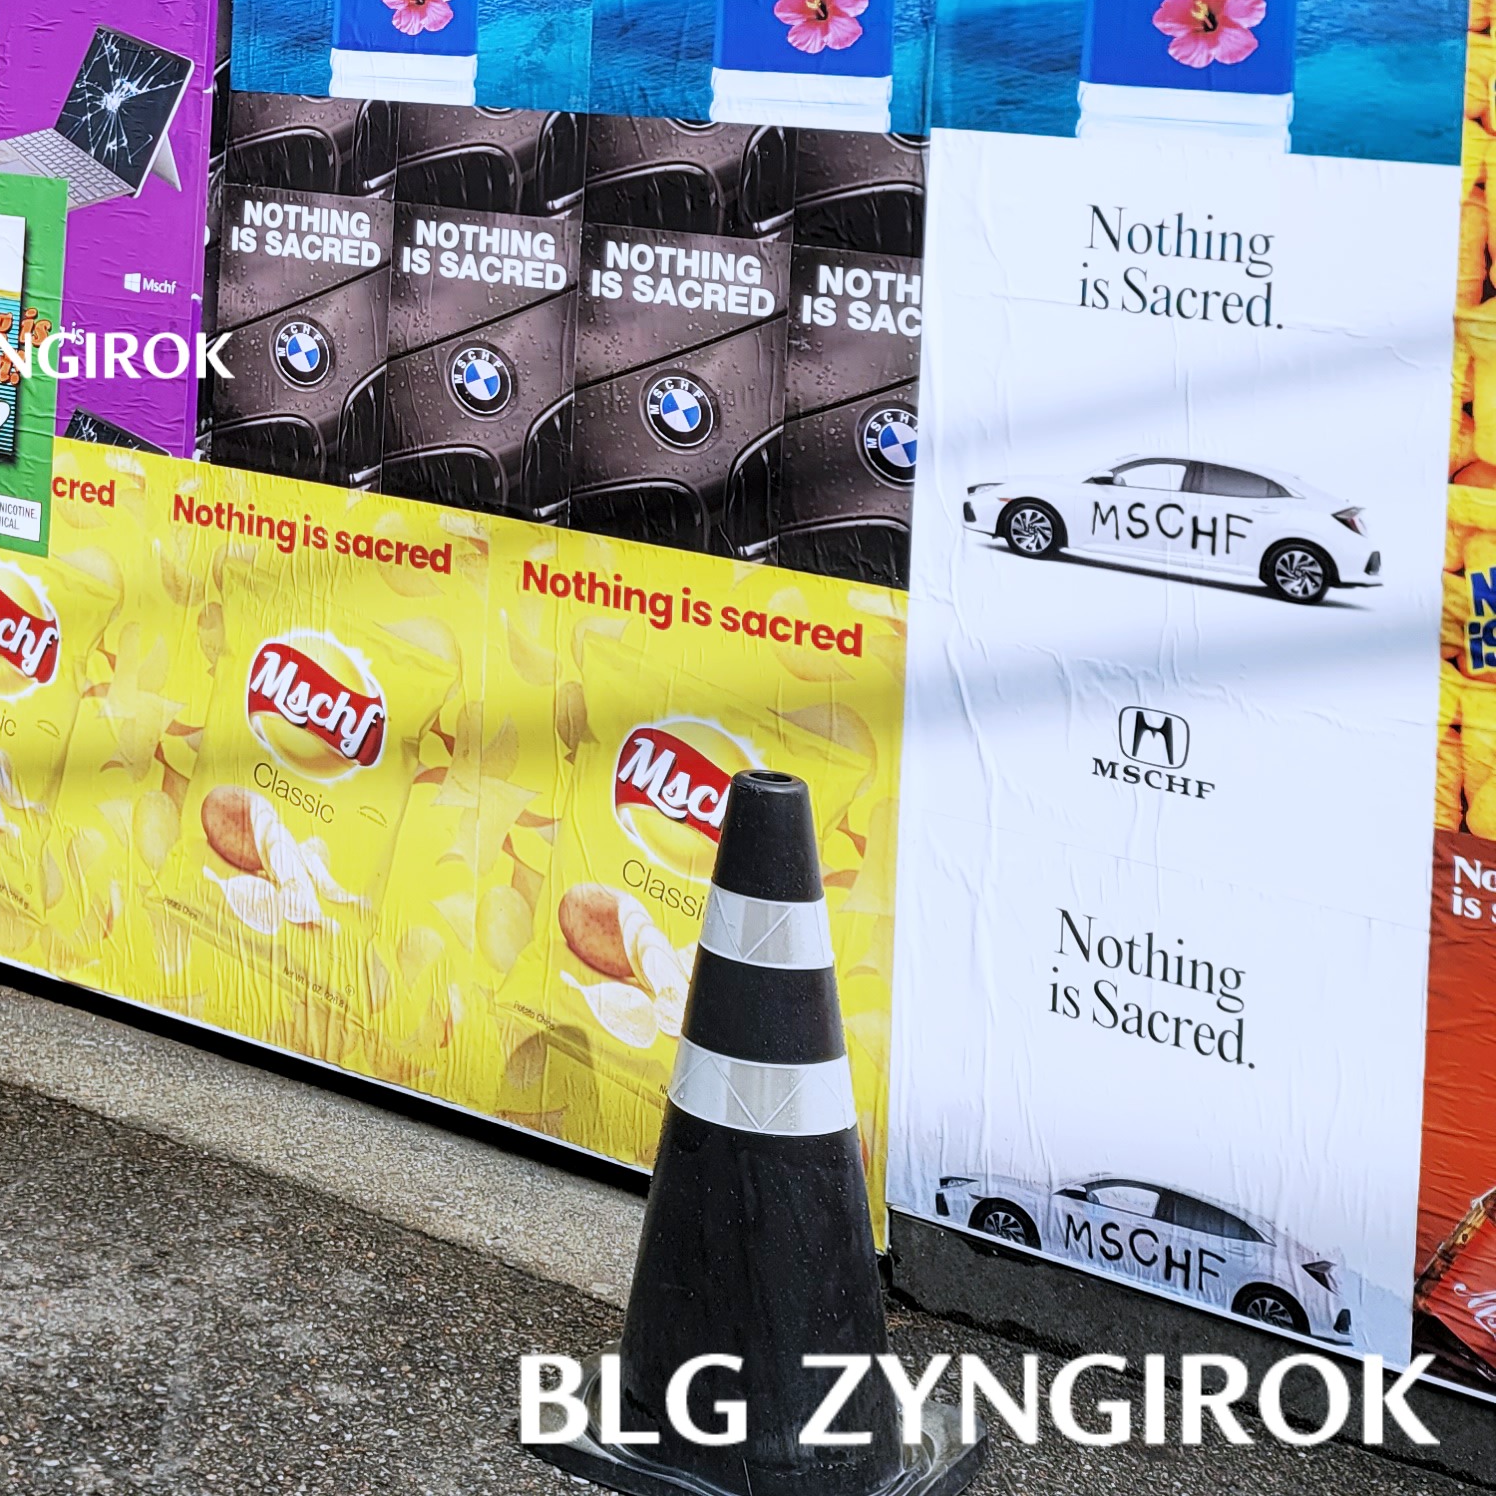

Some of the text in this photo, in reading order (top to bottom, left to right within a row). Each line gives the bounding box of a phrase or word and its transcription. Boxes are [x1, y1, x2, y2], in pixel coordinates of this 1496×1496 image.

[244, 200, 370, 238] NOTHING
[416, 219, 555, 260] NOTHING
[231, 227, 381, 267] IS SACRED
[607, 241, 761, 284] NOTHING
[1085, 205, 1275, 279] Nothing
[142, 277, 177, 296] Mschf
[402, 247, 567, 291] IS SACRED
[819, 265, 921, 303] NOTH
[591, 270, 775, 317] IS SACRED
[1079, 263, 1283, 330] is Sacred.
[20, 307, 52, 348] is
[802, 295, 922, 337] IS SAC
[277, 323, 322, 357] MSCHF
[455, 349, 503, 384] MSCHF
[650, 380, 703, 415] MSCHF
[0, 503, 37, 519] NICOTINE.
[52, 476, 115, 507] cred
[174, 494, 452, 575] Nothing is sacred
[1091, 501, 1253, 556] MSCHF
[522, 560, 864, 658] Nothing is sacred
[250, 651, 384, 758] Mschf
[254, 763, 335, 823] Classic
[1092, 758, 1215, 799] MSCHF
[1054, 907, 1246, 1014] Nothing
[1048, 966, 1255, 1069] is Sacred.
[1064, 1214, 1226, 1292] MSCHF
